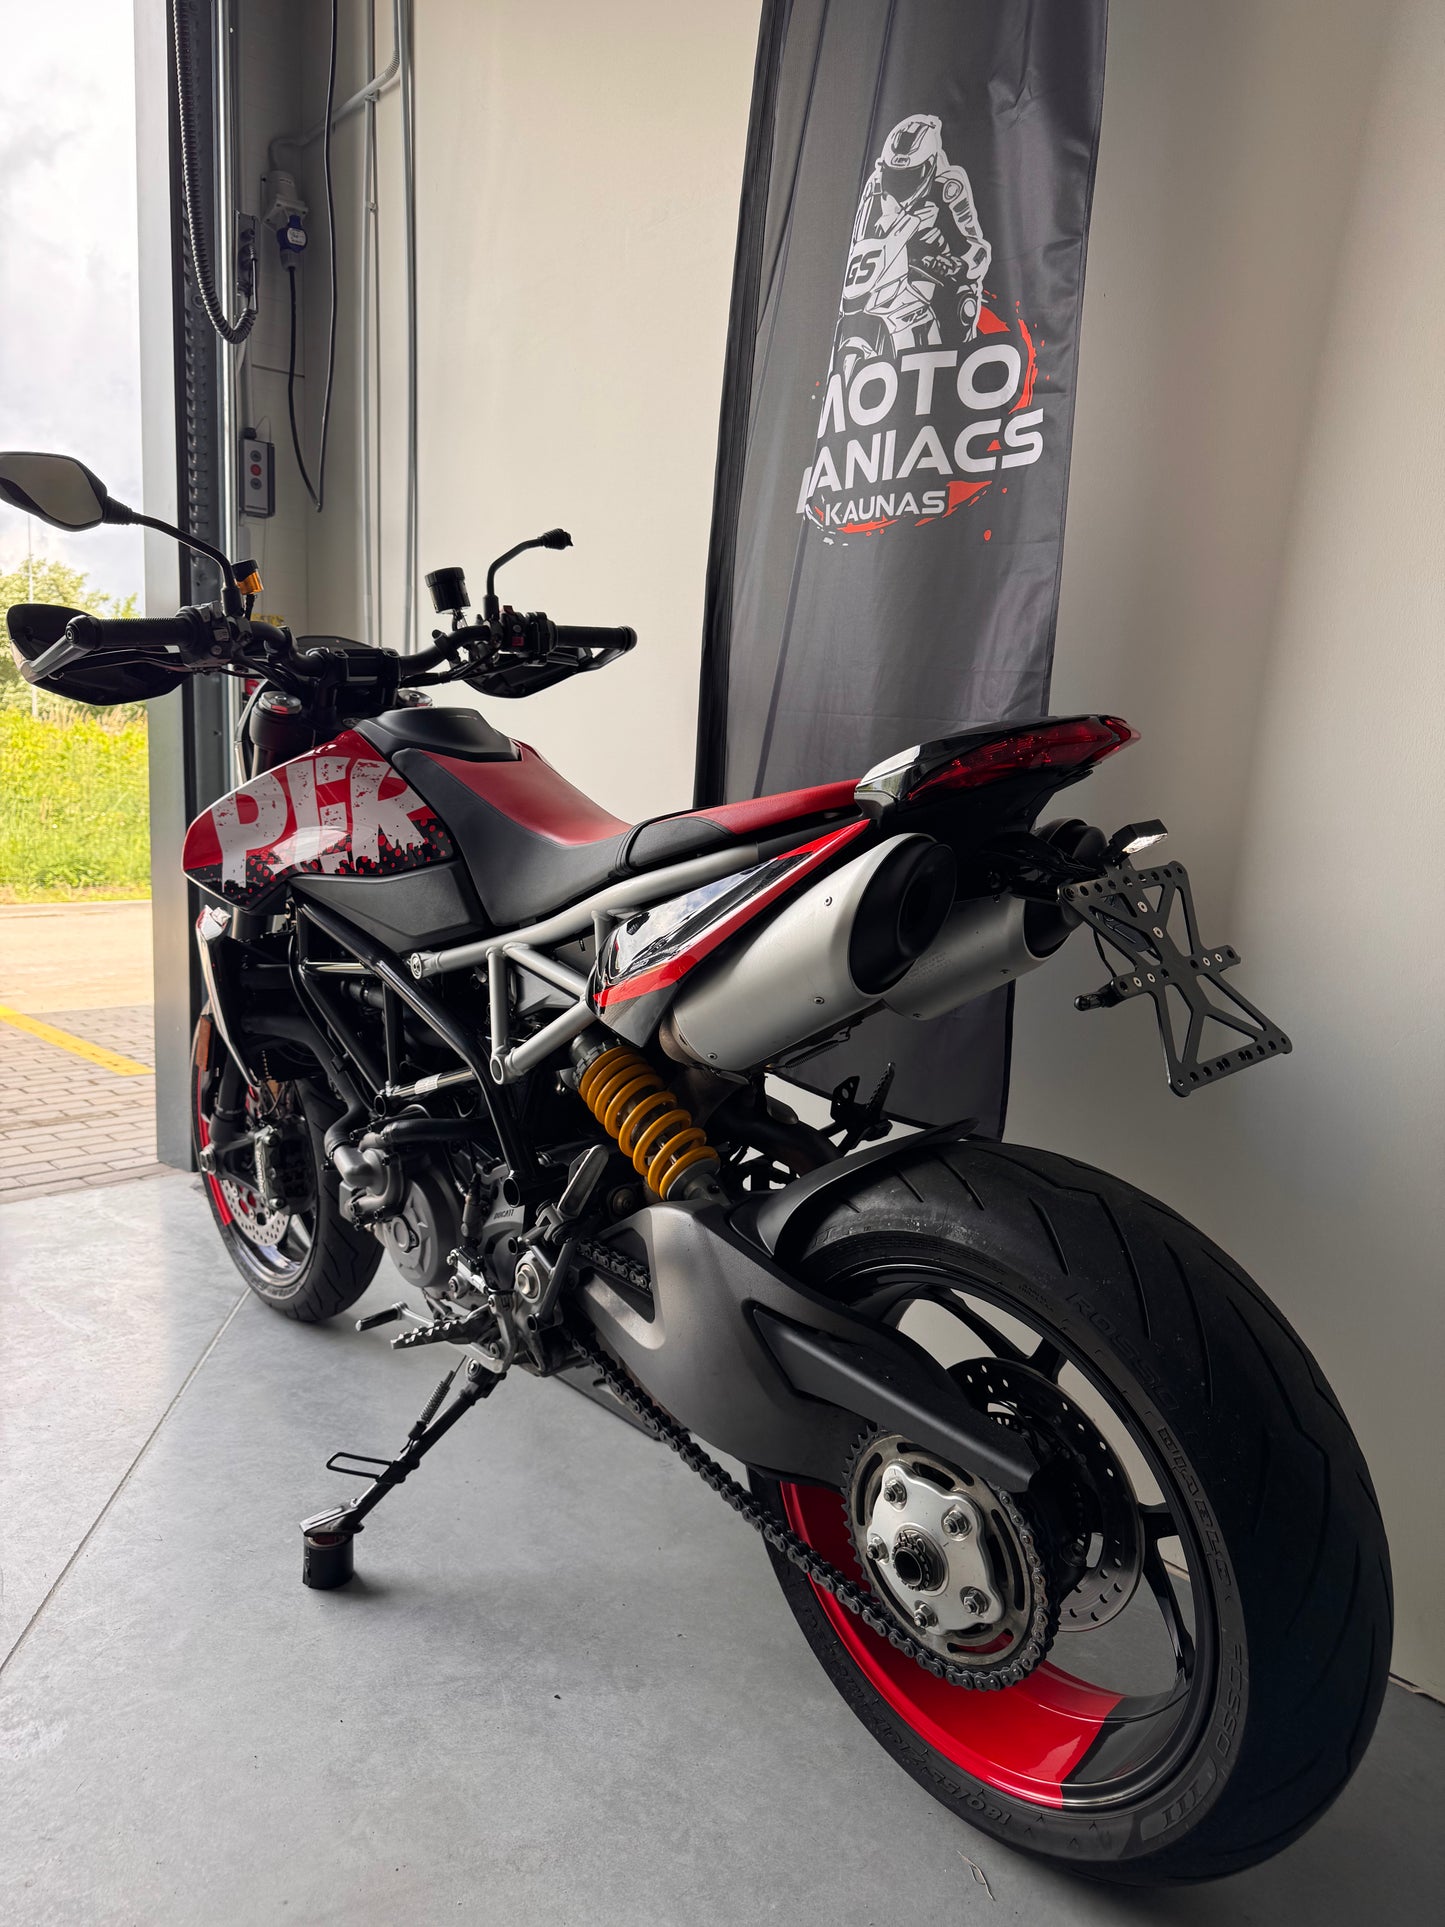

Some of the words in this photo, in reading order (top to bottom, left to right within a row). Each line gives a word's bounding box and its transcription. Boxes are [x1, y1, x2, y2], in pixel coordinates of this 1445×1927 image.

[845, 250, 883, 287] GS
[796, 408, 1044, 514] ANIACS
[825, 491, 946, 526] KAUNAS
